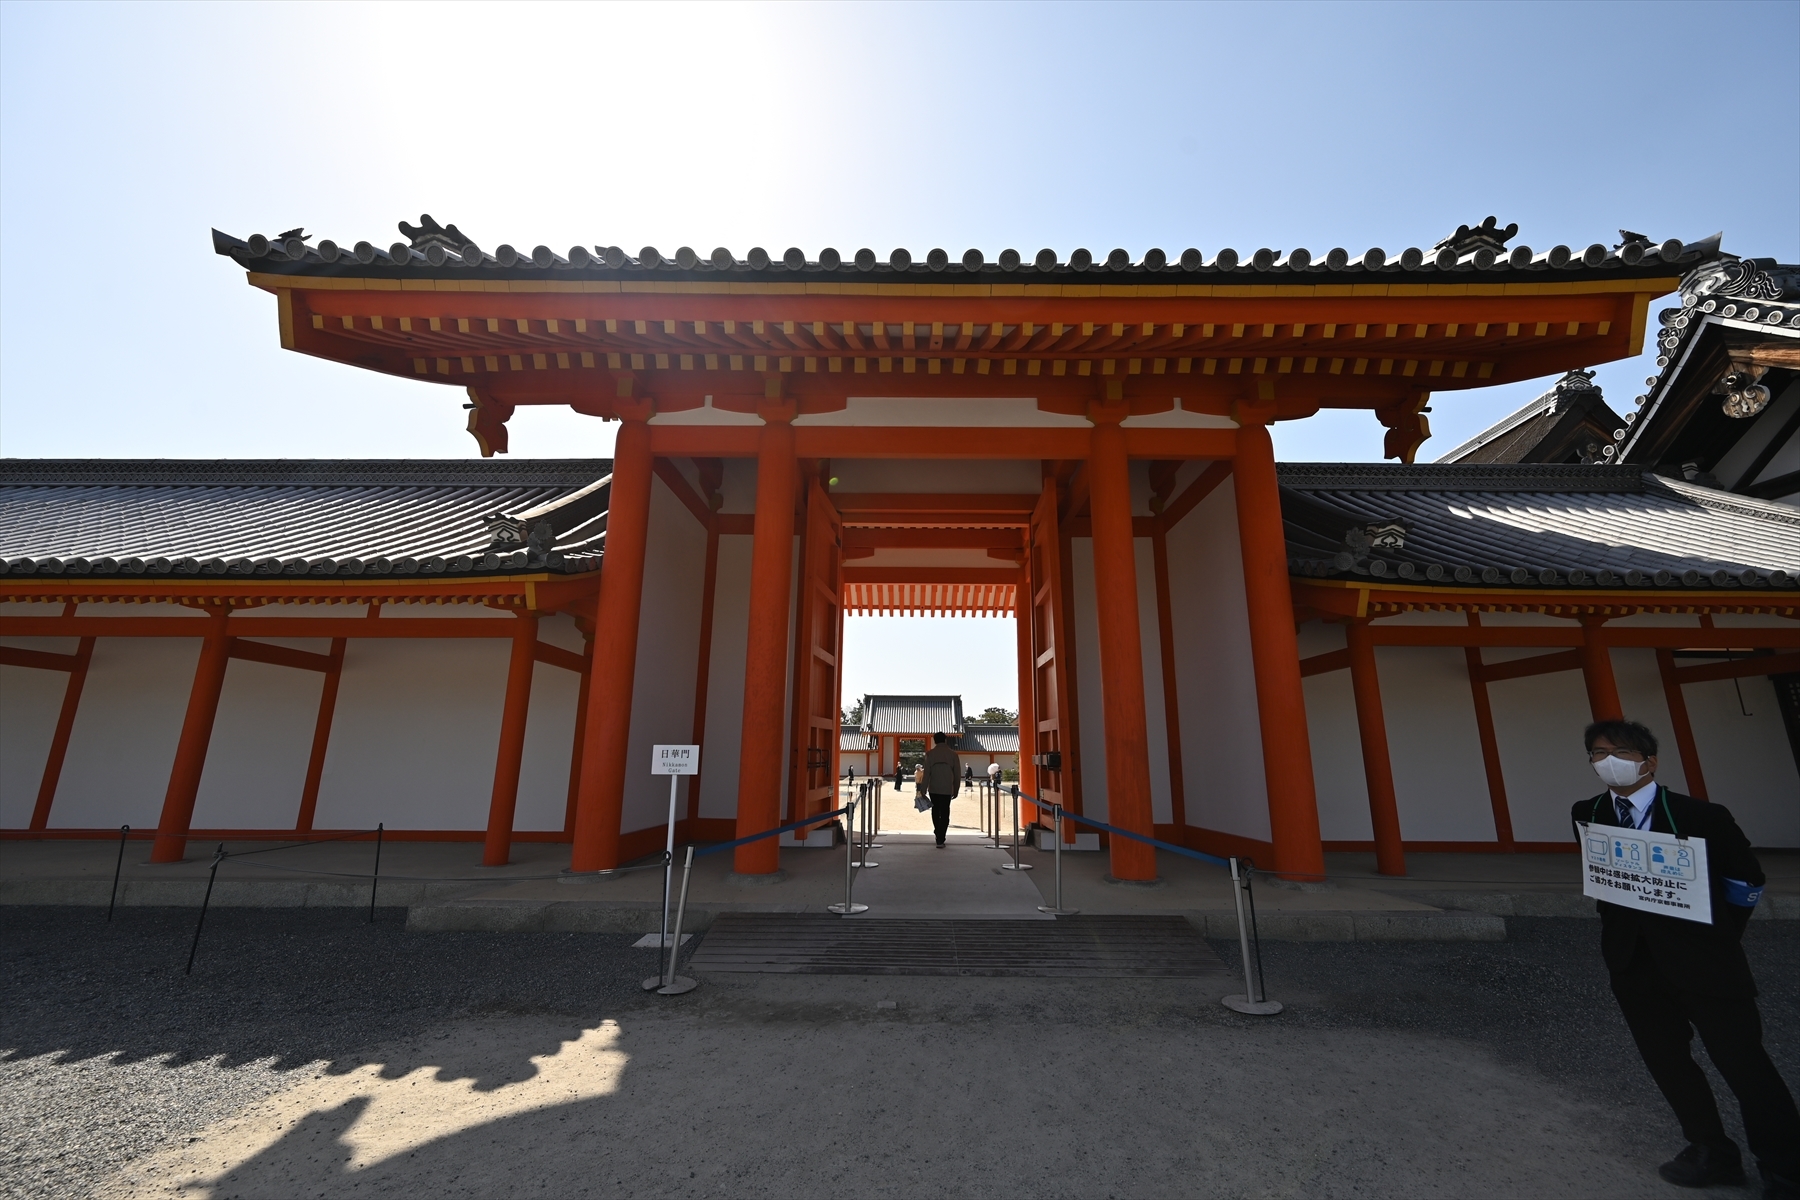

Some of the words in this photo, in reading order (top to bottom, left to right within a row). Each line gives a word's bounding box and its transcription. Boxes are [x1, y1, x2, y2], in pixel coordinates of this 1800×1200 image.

[662, 749, 690, 758] 日華門
[1614, 862, 1642, 870] ディスタンス
[1590, 875, 1681, 900] ご協力をお願いします。
[1638, 895, 1691, 910] 宮内庁京都事務所
